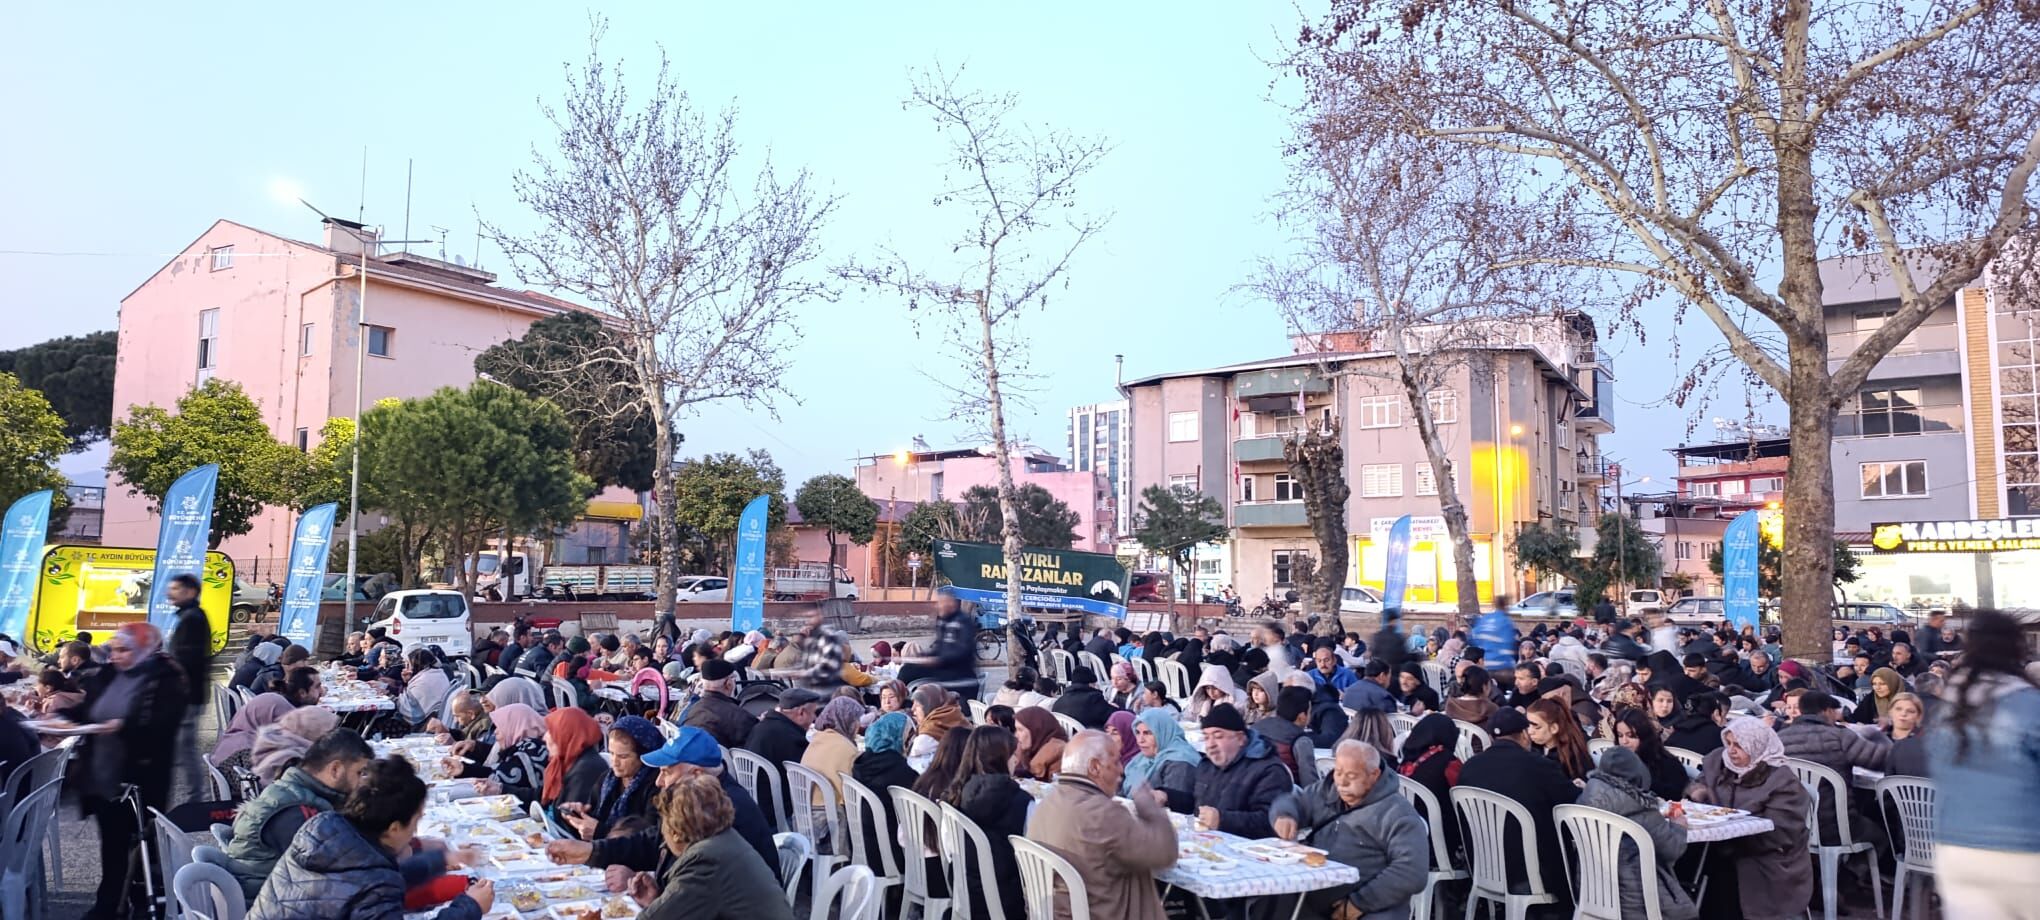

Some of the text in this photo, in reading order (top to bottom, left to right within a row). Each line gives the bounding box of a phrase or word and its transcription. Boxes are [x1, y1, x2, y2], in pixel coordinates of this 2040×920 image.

[125, 553, 154, 562] BÜYÜKŞ
[1003, 552, 1060, 569] YIRLI
[981, 564, 1083, 586] RAZANLAR
